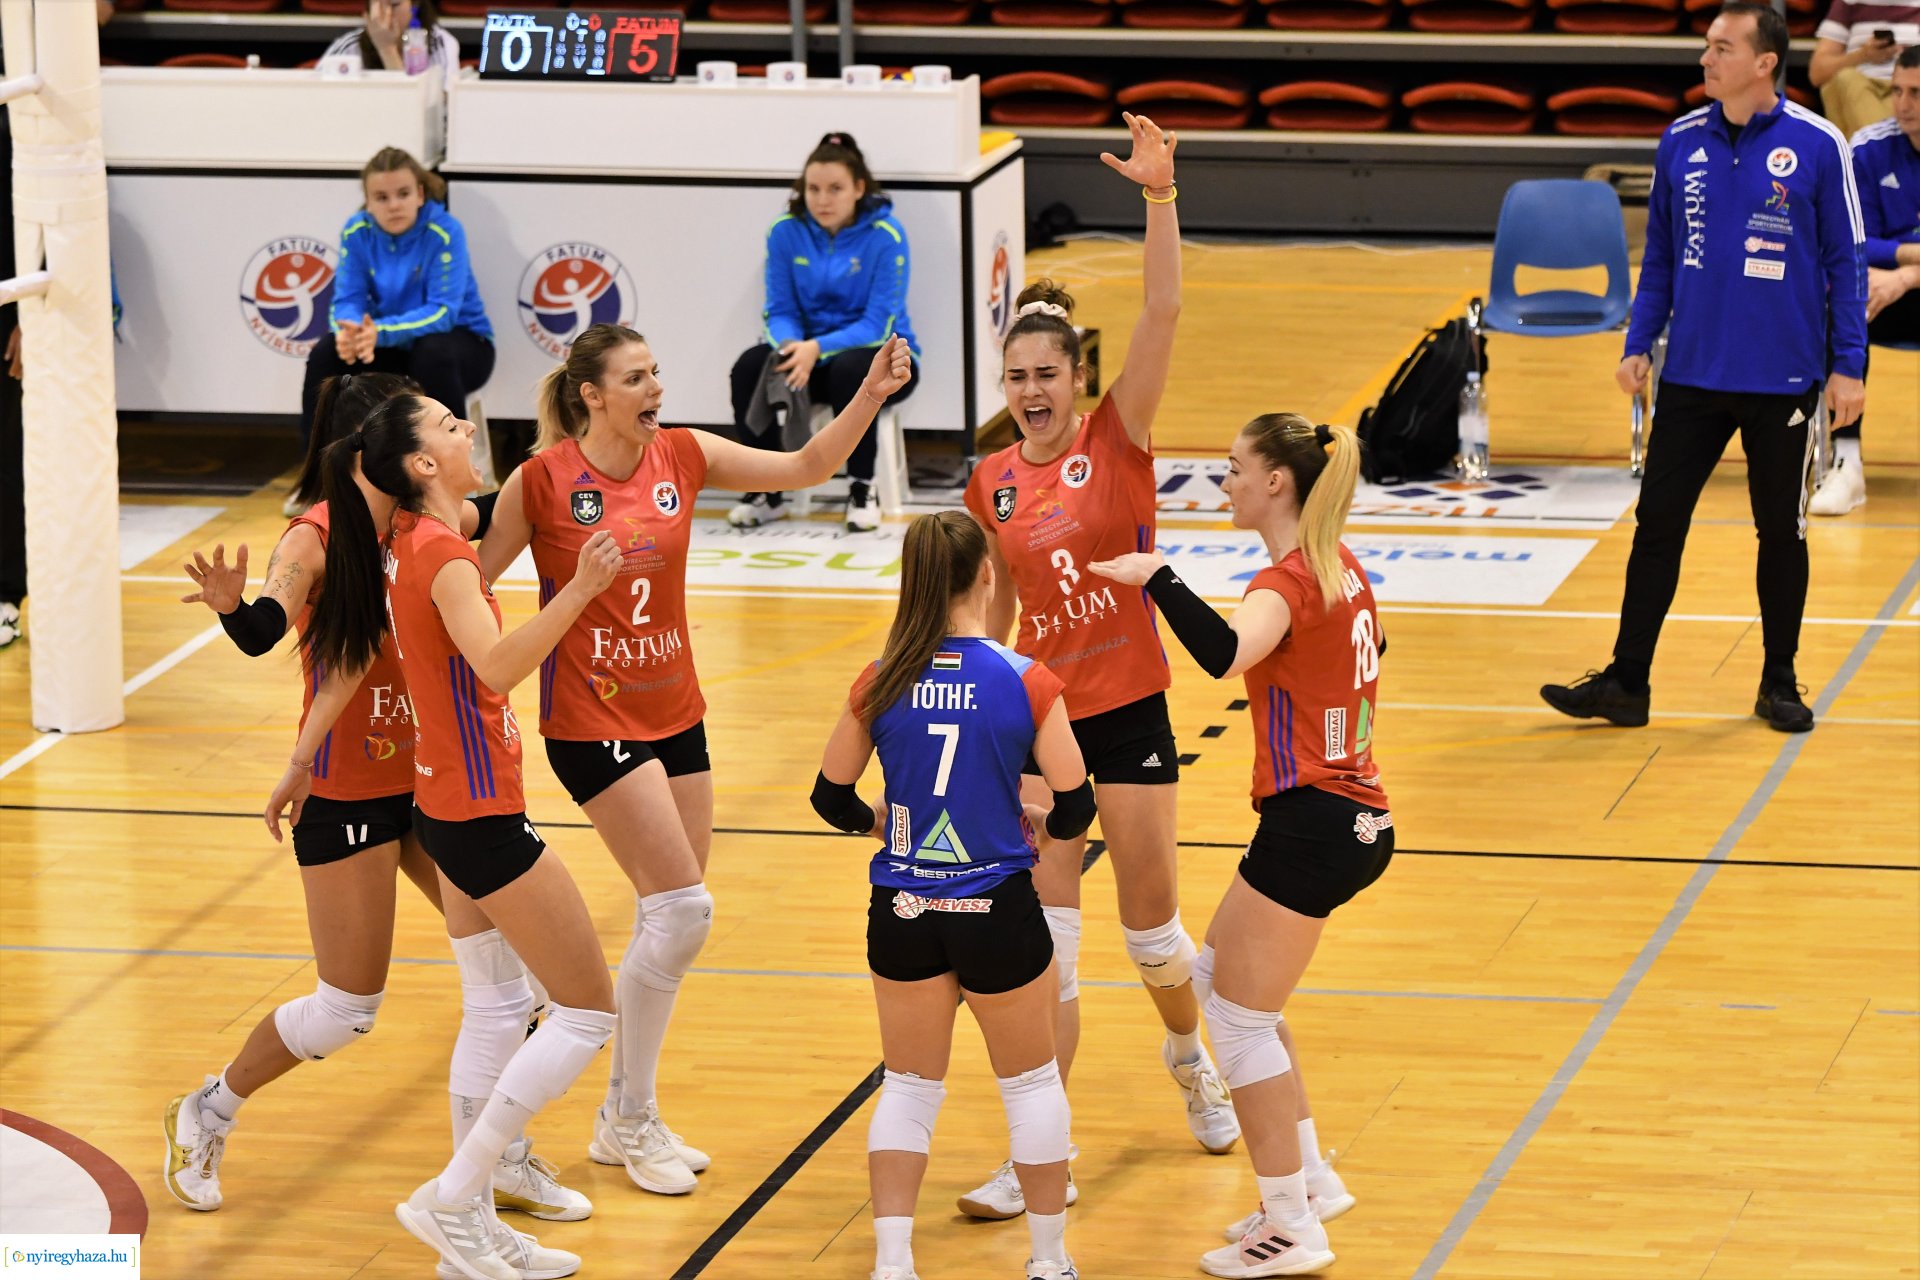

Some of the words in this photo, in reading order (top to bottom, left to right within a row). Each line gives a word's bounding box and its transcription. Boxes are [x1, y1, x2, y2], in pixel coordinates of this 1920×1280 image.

[615, 17, 679, 31] FATUM
[501, 31, 532, 72] 0
[627, 33, 658, 74] 5
[1683, 169, 1702, 267] FATUM
[268, 240, 327, 257] FATUM
[546, 246, 606, 262] FATUM
[1028, 521, 1079, 548] SPORTCENTRUM
[618, 561, 666, 572] PORTCENTRUM
[622, 554, 663, 565] YÍREGYHÁZI
[1051, 549, 1080, 596] 3
[631, 577, 651, 626] 2
[1031, 586, 1118, 641] FUM
[590, 626, 682, 660] FATUM
[1351, 608, 1379, 690] 18
[911, 679, 961, 710] TÓTH
[963, 683, 978, 710] F.
[1331, 710, 1340, 758] STRABAG
[927, 723, 960, 797] 7
[897, 807, 906, 854] STRABAG
[927, 899, 991, 912] REVESZ
